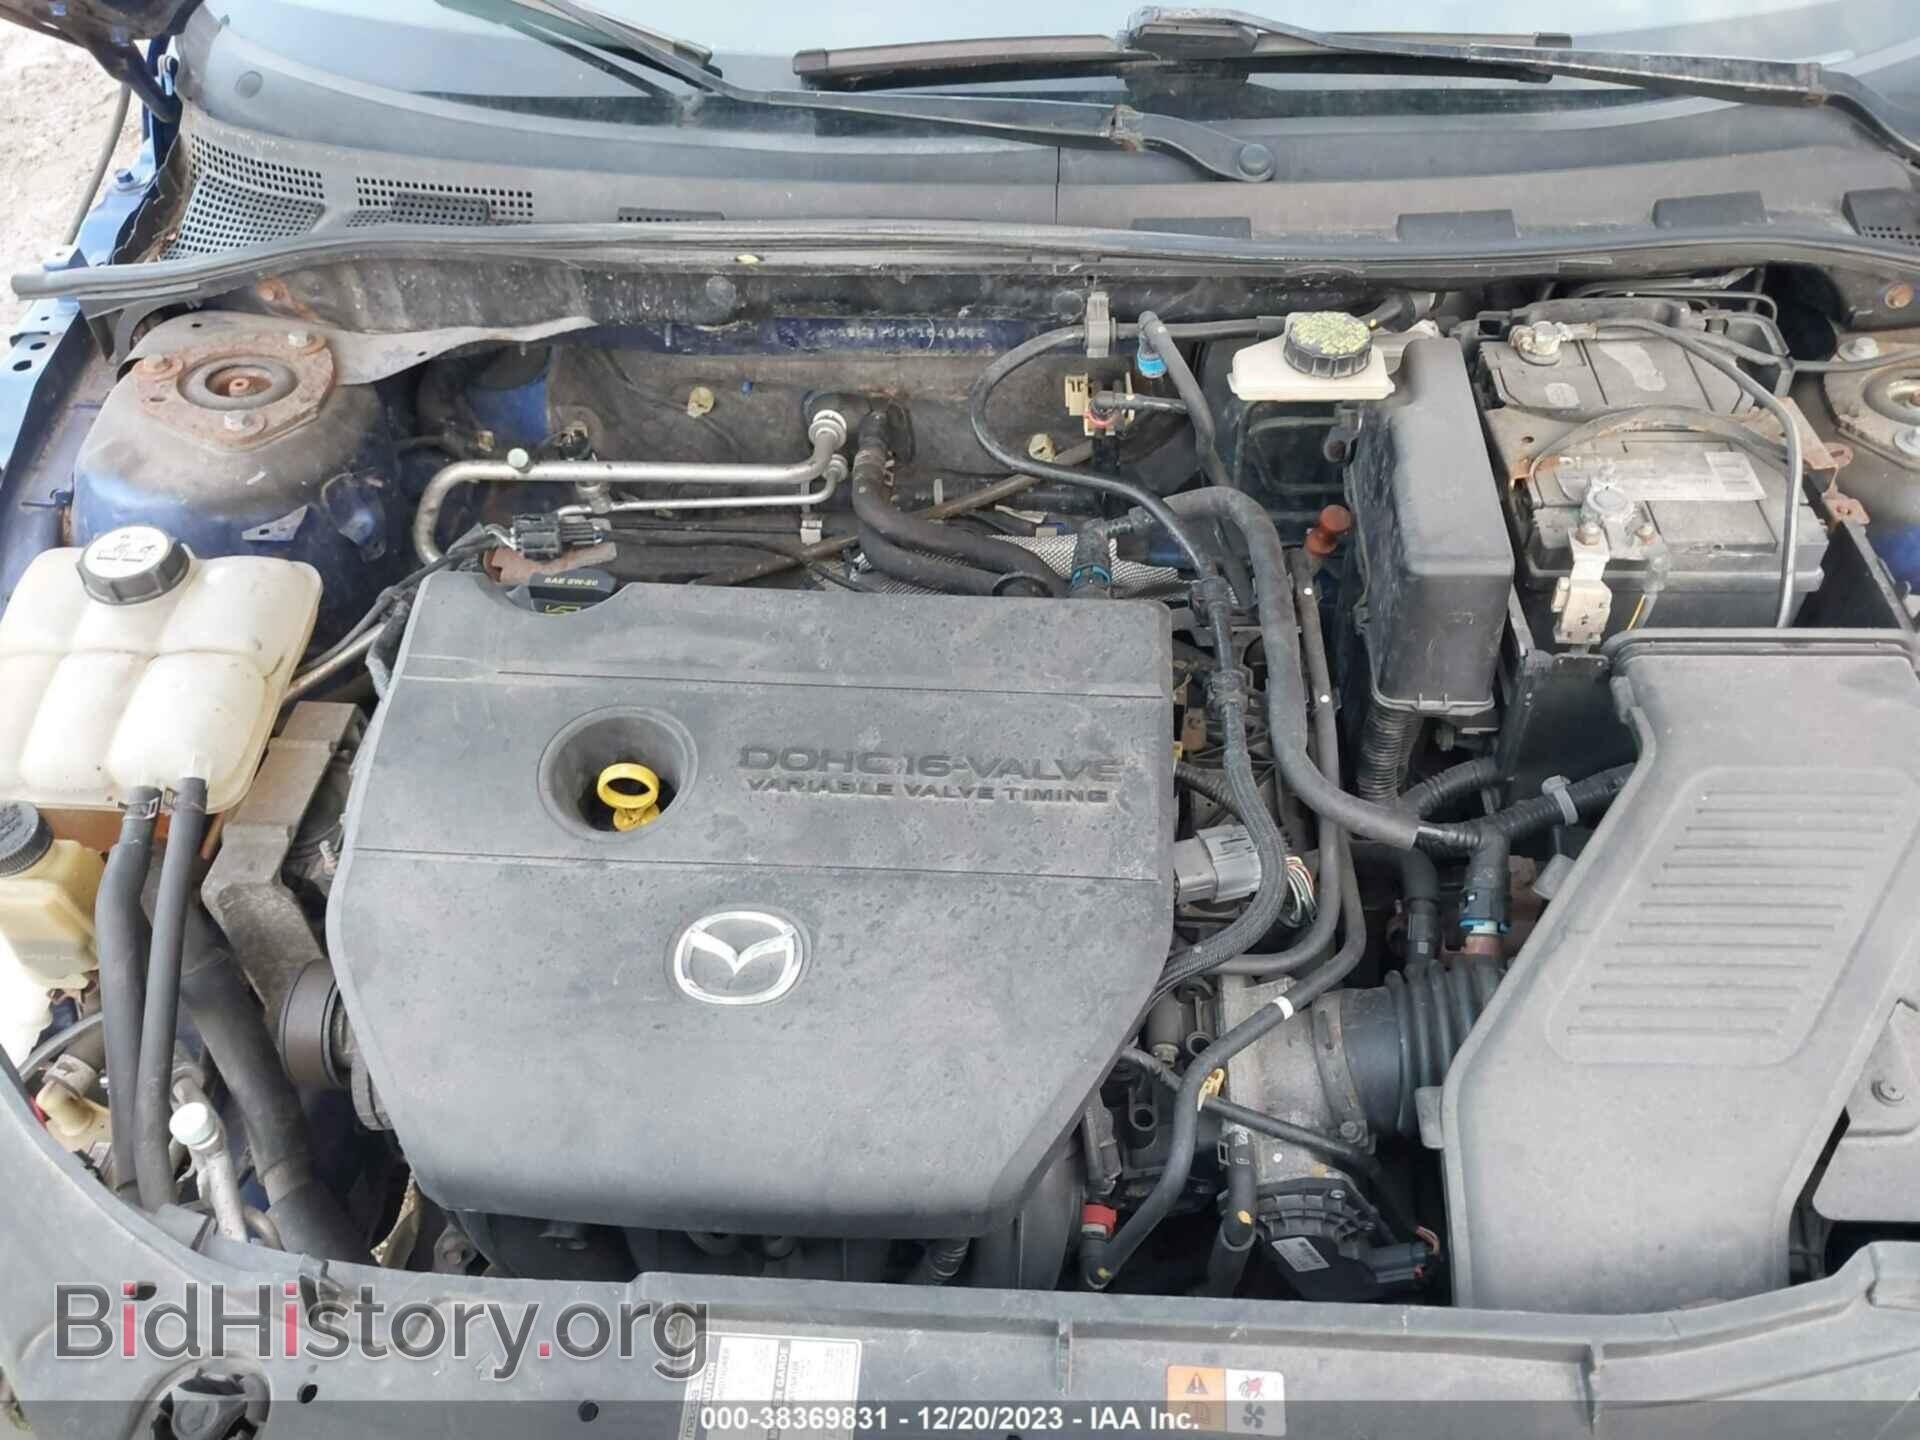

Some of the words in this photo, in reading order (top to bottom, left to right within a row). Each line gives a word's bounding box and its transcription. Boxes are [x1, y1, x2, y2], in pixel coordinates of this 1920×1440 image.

[740, 746, 895, 775] DOHC
[903, 754, 1124, 783] 16-VALVE
[747, 777, 895, 797] VARIABLE
[903, 782, 996, 800] VALVE
[1004, 786, 1109, 804] TIMING
